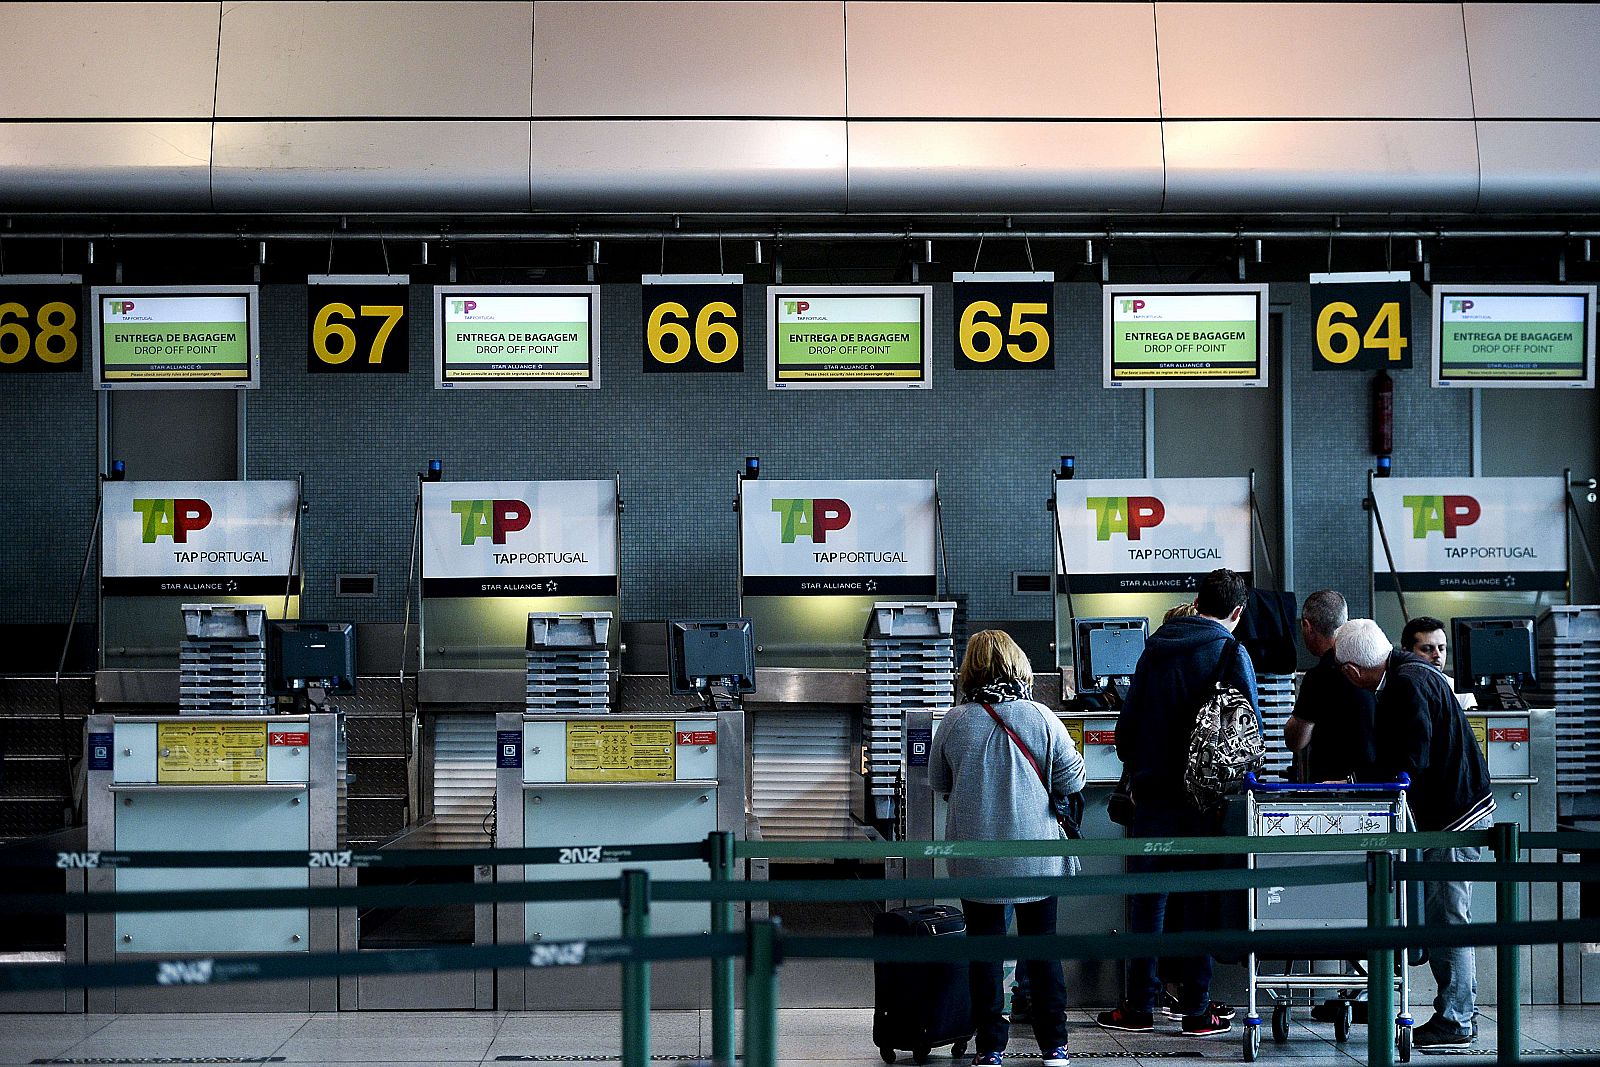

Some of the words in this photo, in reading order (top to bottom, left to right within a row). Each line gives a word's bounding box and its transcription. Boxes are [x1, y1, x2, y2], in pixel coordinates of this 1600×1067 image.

[109, 301, 134, 314] TAP
[451, 301, 476, 314] TAP
[784, 302, 809, 314] TAP
[0, 302, 77, 364] 68
[115, 334, 163, 342] ENTREGA
[312, 302, 404, 364] 67
[646, 302, 739, 364] 66
[960, 301, 1050, 363] 65
[1316, 302, 1408, 364] 64
[1521, 333, 1572, 341] BAGAGEM
[135, 346, 162, 354] DROP
[165, 346, 184, 354] OFF
[187, 346, 217, 354] POINT
[809, 346, 836, 355] DROP
[839, 346, 857, 354] OFF
[861, 346, 891, 354] POINT
[1144, 345, 1172, 353] DROP
[1175, 344, 1193, 352] OFF
[1196, 344, 1226, 352] POINT
[1472, 345, 1500, 353] DROP
[1502, 345, 1521, 353] OFF
[1524, 345, 1554, 353] POINT
[133, 499, 212, 543] TAP
[451, 500, 532, 545] TAP
[772, 499, 852, 543] TAP
[1087, 497, 1165, 541] TAP
[1403, 495, 1481, 538] TAP
[174, 552, 198, 562] TAP
[200, 552, 268, 562] PORTUGAL
[493, 554, 517, 564] TAP
[520, 553, 588, 563] PORTUGAL
[813, 553, 837, 562] TAP
[840, 552, 907, 562] PORTUGAL
[1128, 550, 1152, 559] TAP
[1155, 549, 1221, 559] PORTUGAL
[1445, 548, 1468, 558] TAP
[1471, 547, 1537, 558] PORTUGAL
